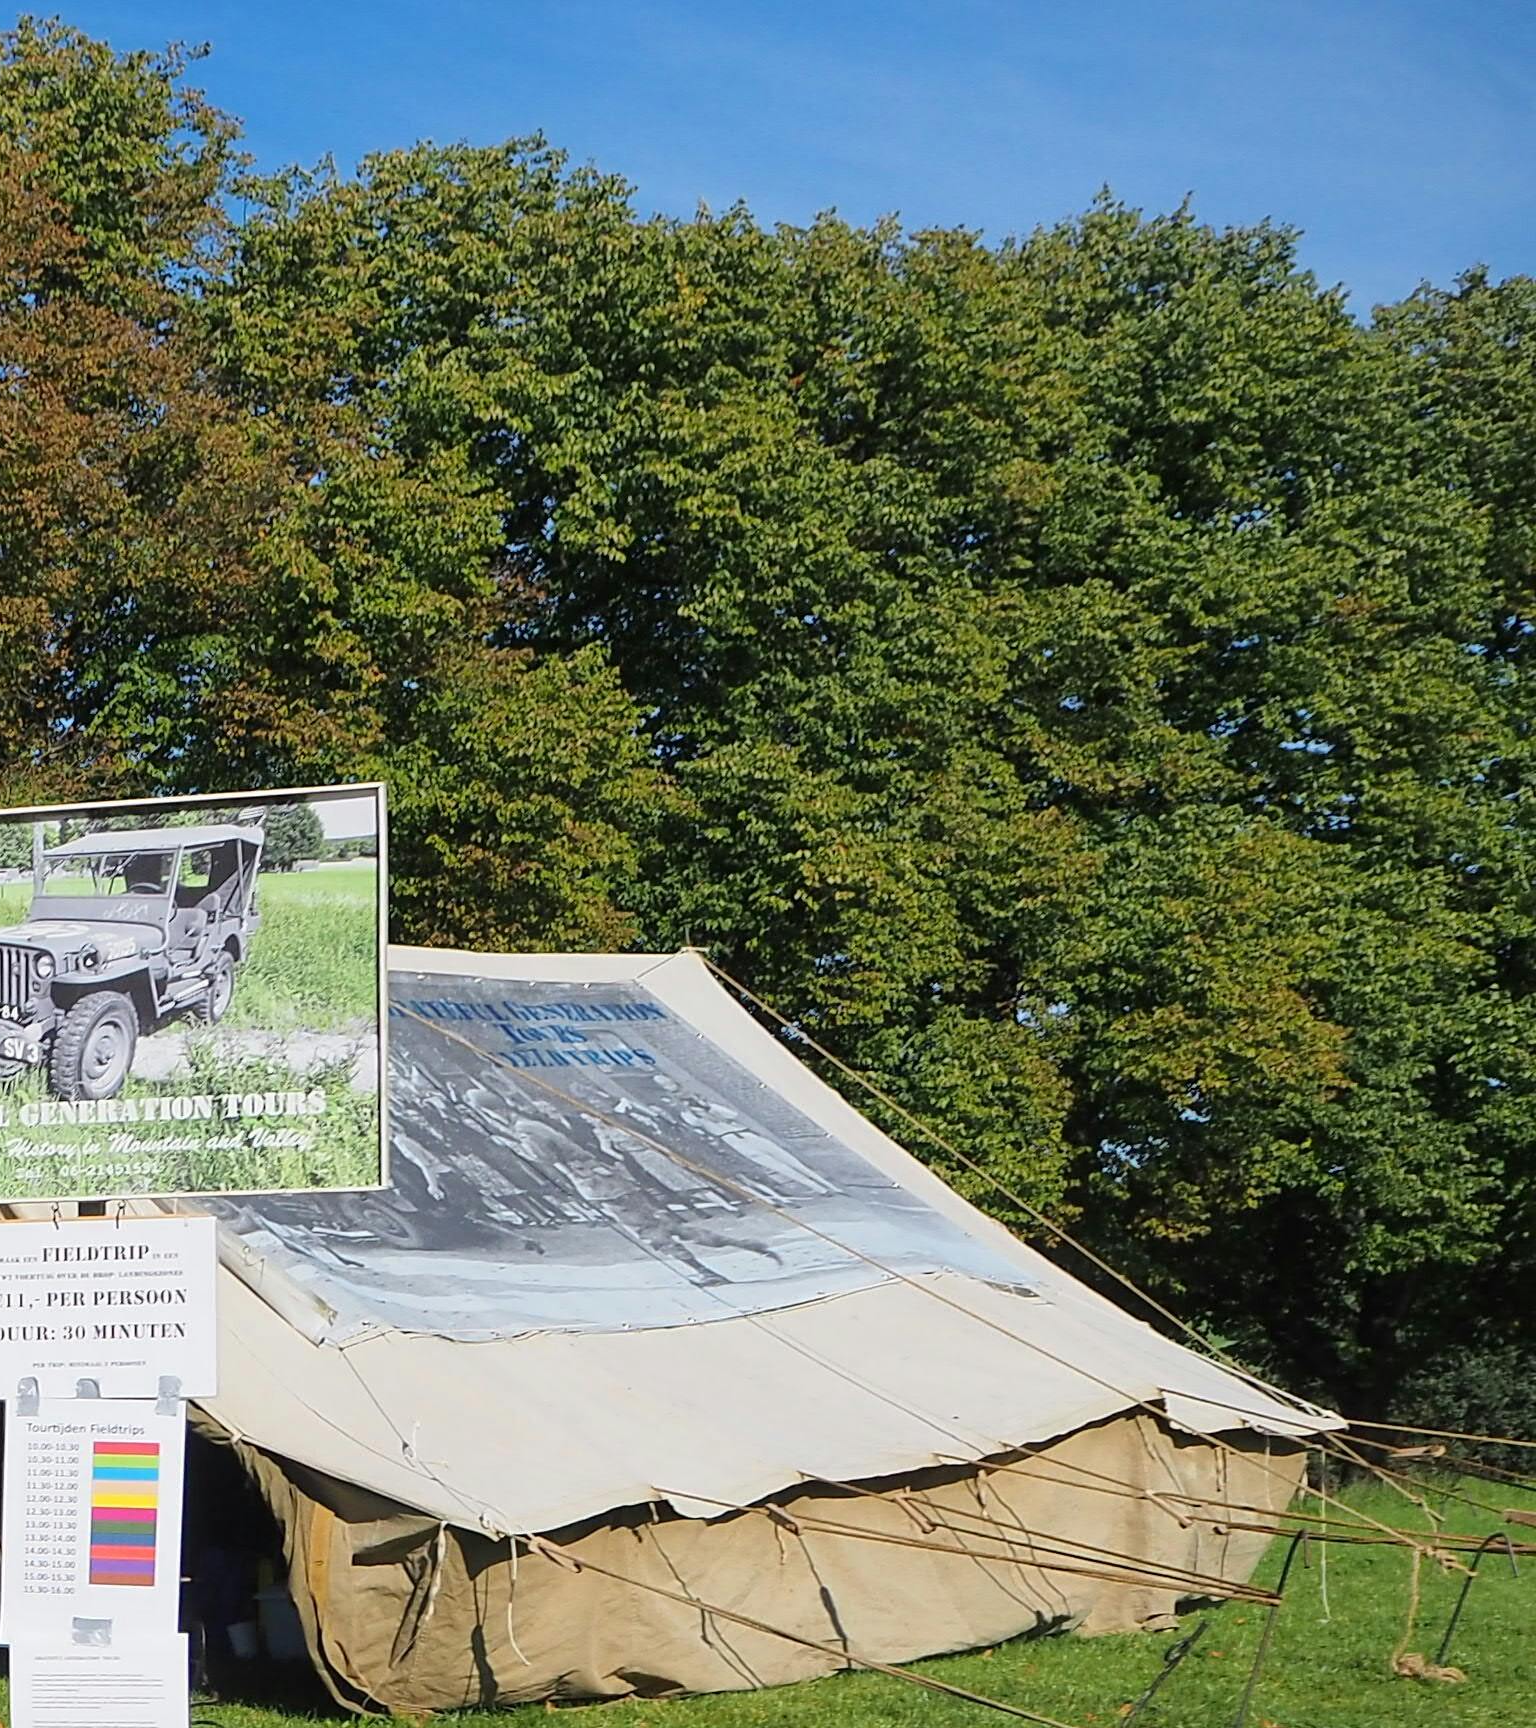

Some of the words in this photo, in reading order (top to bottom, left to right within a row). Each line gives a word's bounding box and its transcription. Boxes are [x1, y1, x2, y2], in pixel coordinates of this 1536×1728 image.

[19, 1094, 214, 1127] GENERATION
[222, 1089, 327, 1119] TOURS
[6, 1138, 78, 1163] History
[82, 1140, 102, 1156] in
[108, 1131, 202, 1154] Mountain
[206, 1131, 246, 1150] and
[246, 1127, 313, 1153] Valley
[42, 1245, 150, 1263] FIELDTRIP
[47, 1292, 86, 1307] PER
[93, 1289, 188, 1306] PERSOON
[63, 1325, 86, 1341] 30
[92, 1323, 187, 1340] MINUTEN
[26, 1422, 86, 1435] Tourtijden
[90, 1424, 145, 1436] Fieldtrips
